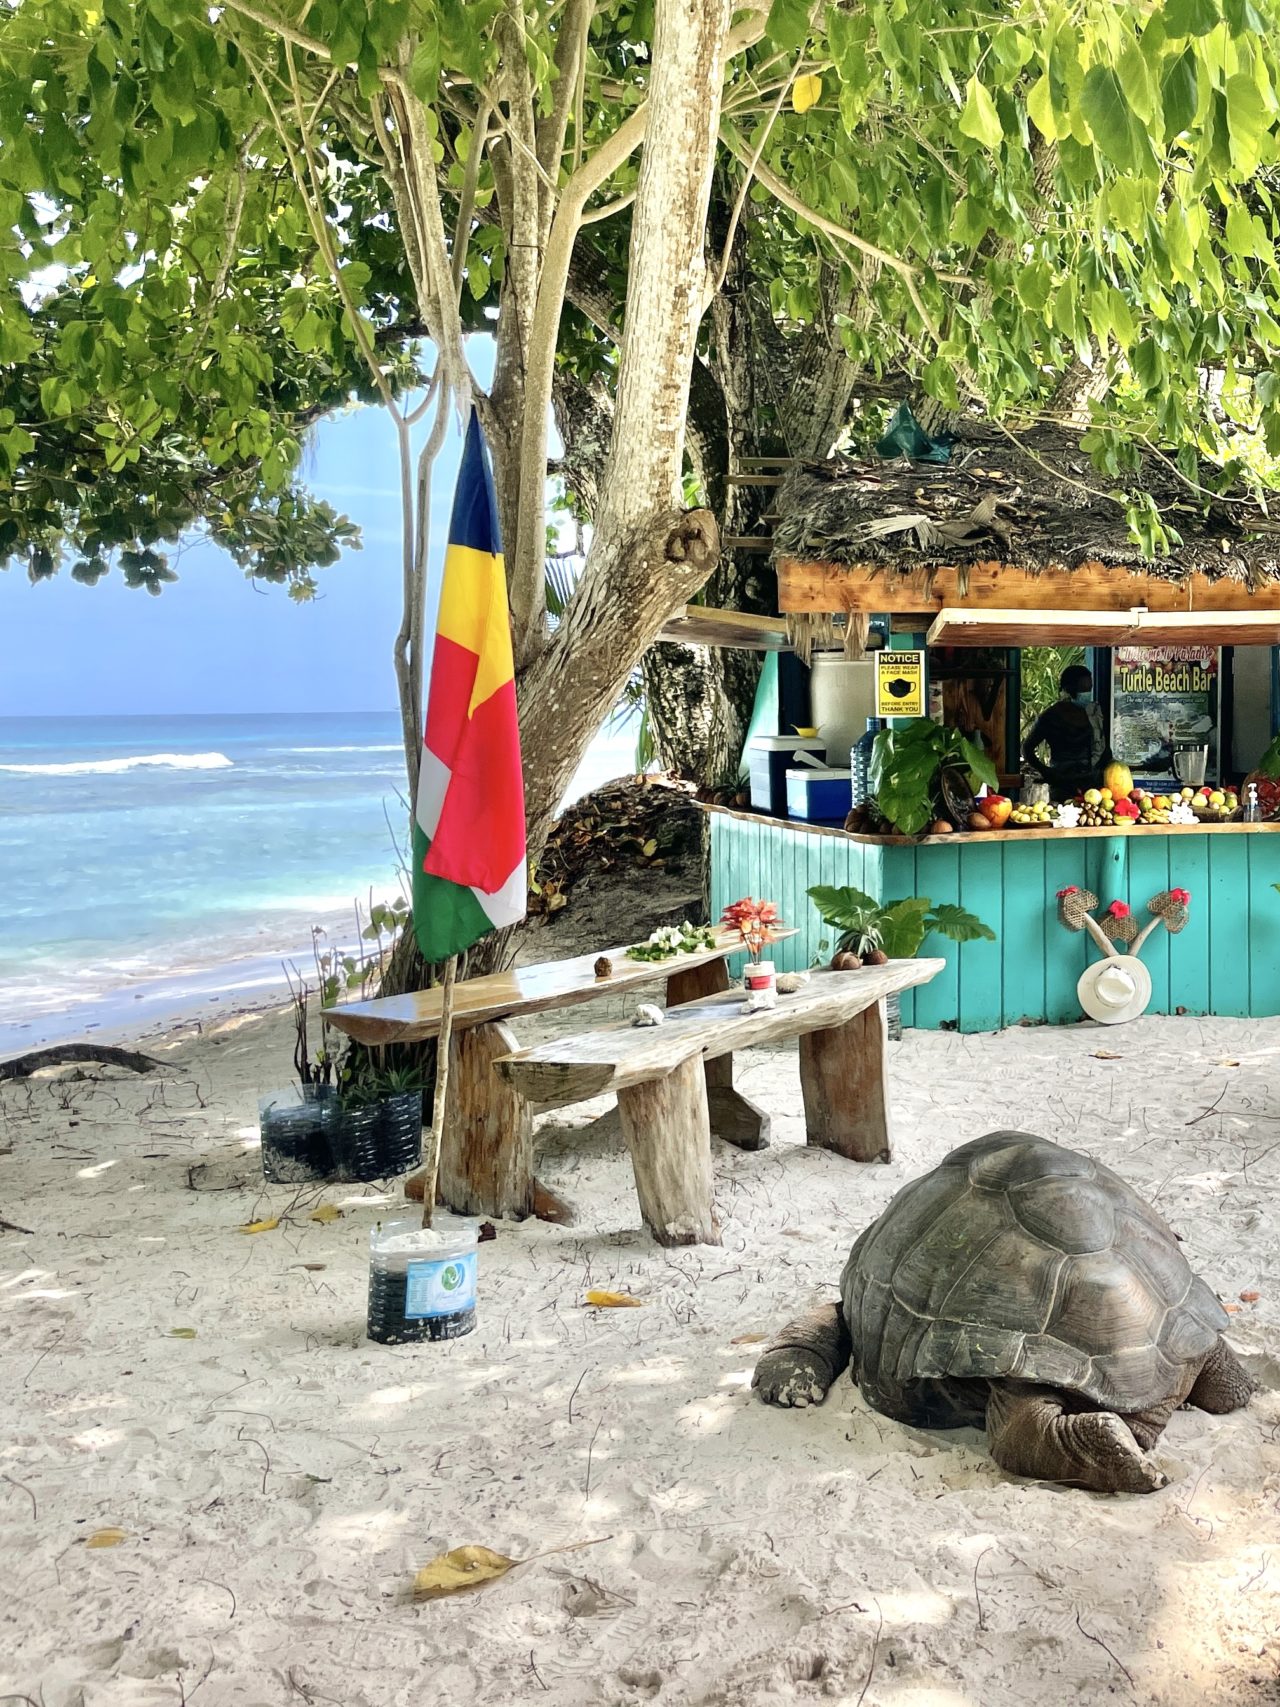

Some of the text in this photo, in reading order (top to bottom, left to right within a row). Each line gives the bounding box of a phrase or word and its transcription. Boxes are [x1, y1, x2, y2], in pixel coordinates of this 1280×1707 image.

[880, 654, 919, 662] NOTICE
[1120, 665, 1153, 693] Turtle
[1155, 665, 1190, 693] Beach
